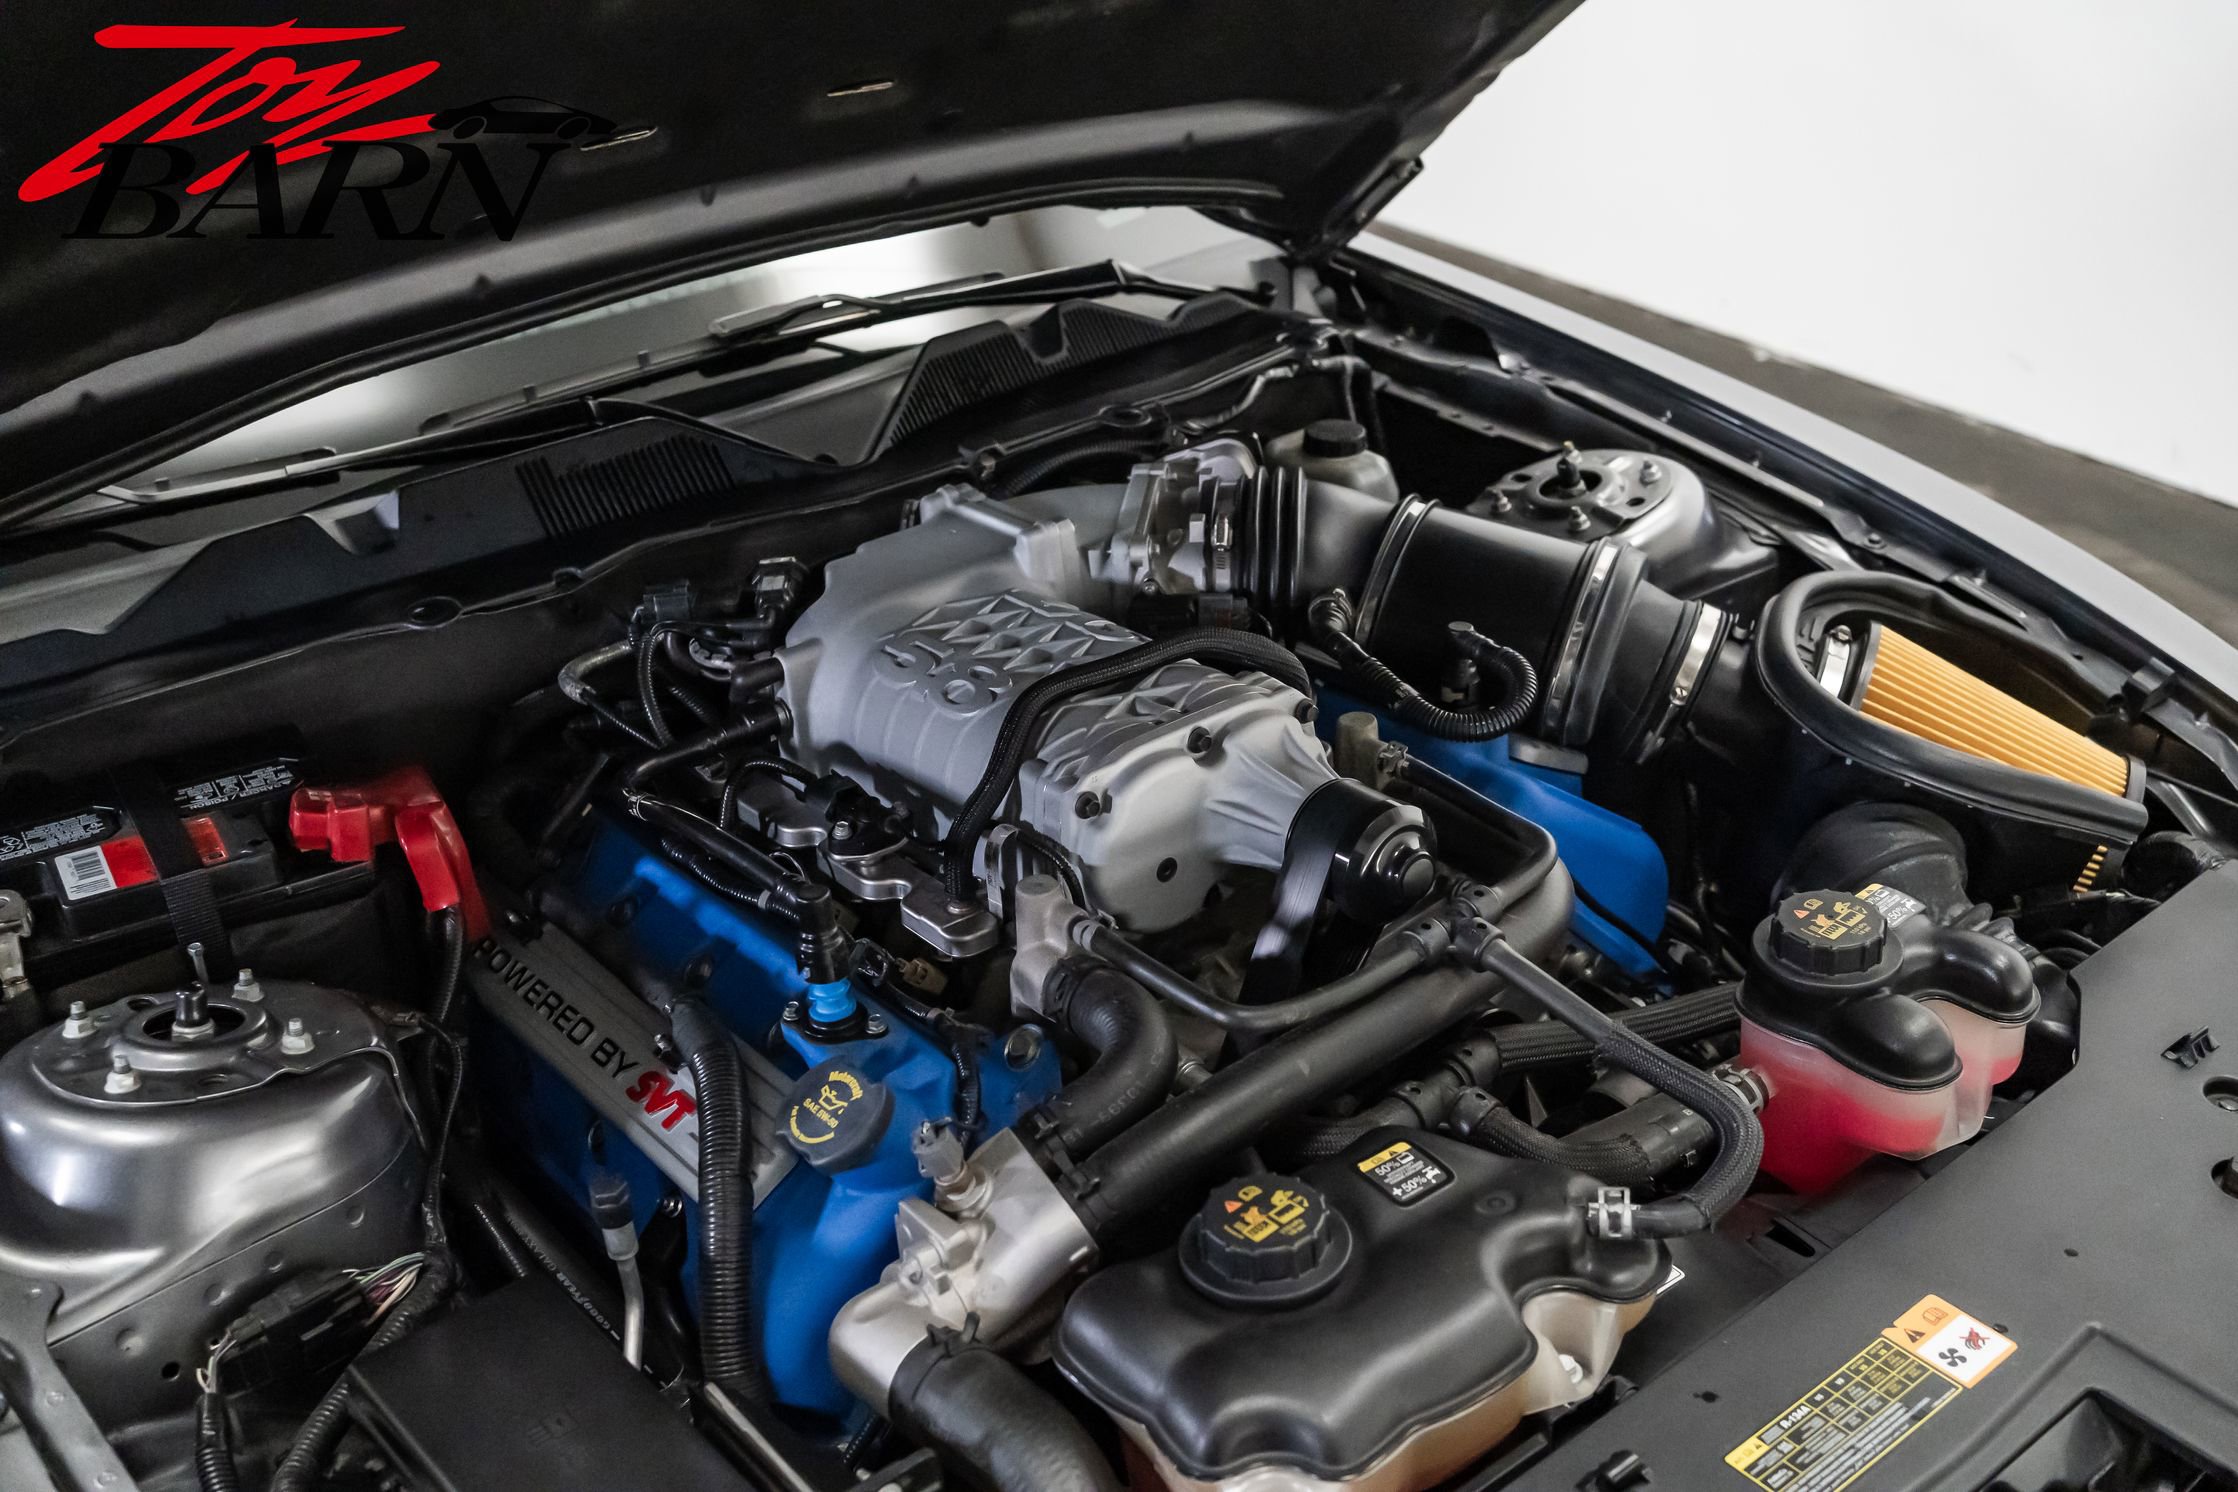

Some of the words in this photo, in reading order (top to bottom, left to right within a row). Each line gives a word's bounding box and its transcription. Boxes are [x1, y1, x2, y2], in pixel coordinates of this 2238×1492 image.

[473, 938, 595, 1046] POWERED
[590, 1037, 639, 1079] BY
[625, 1070, 698, 1131] SVT
[1374, 1160, 1401, 1176] 50%
